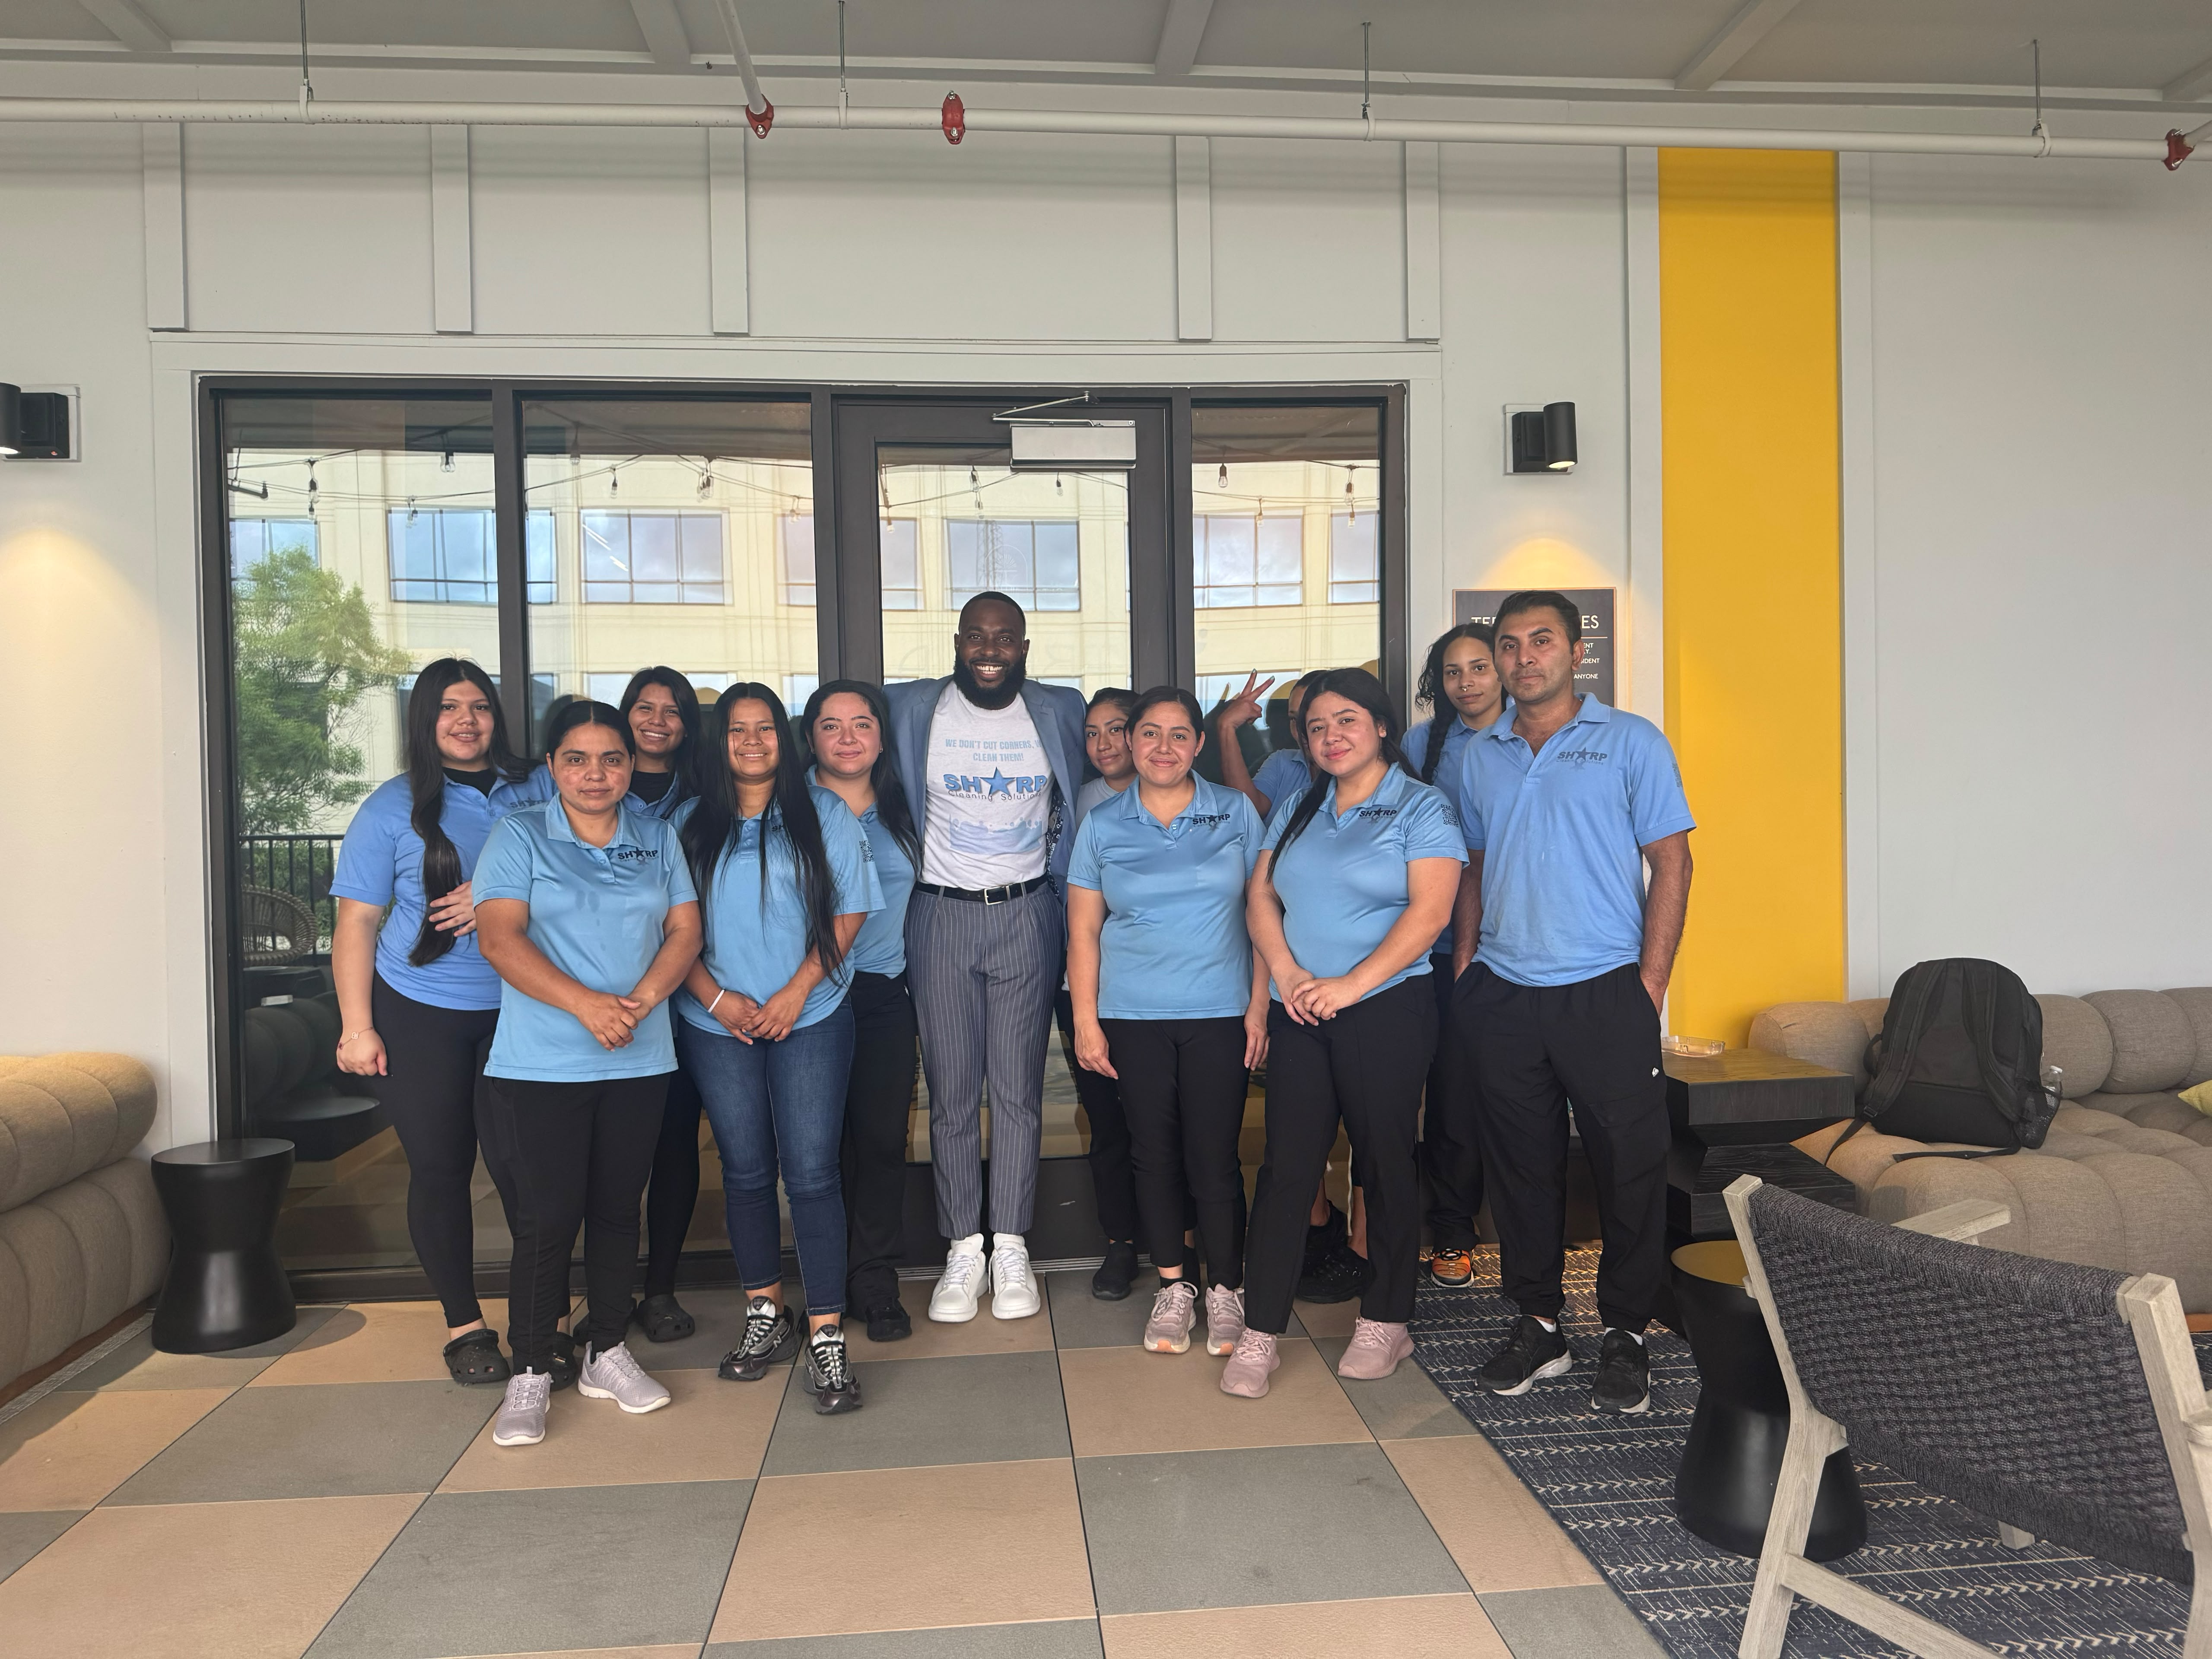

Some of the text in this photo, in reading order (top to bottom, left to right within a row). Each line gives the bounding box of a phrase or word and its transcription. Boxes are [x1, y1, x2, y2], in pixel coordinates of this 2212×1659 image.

[945, 739, 1042, 750] WE DON'T CUT CORNERS, W
[973, 753, 1024, 761] CLEAN THEM!
[948, 790, 1042, 801] Cleaning Solutios
